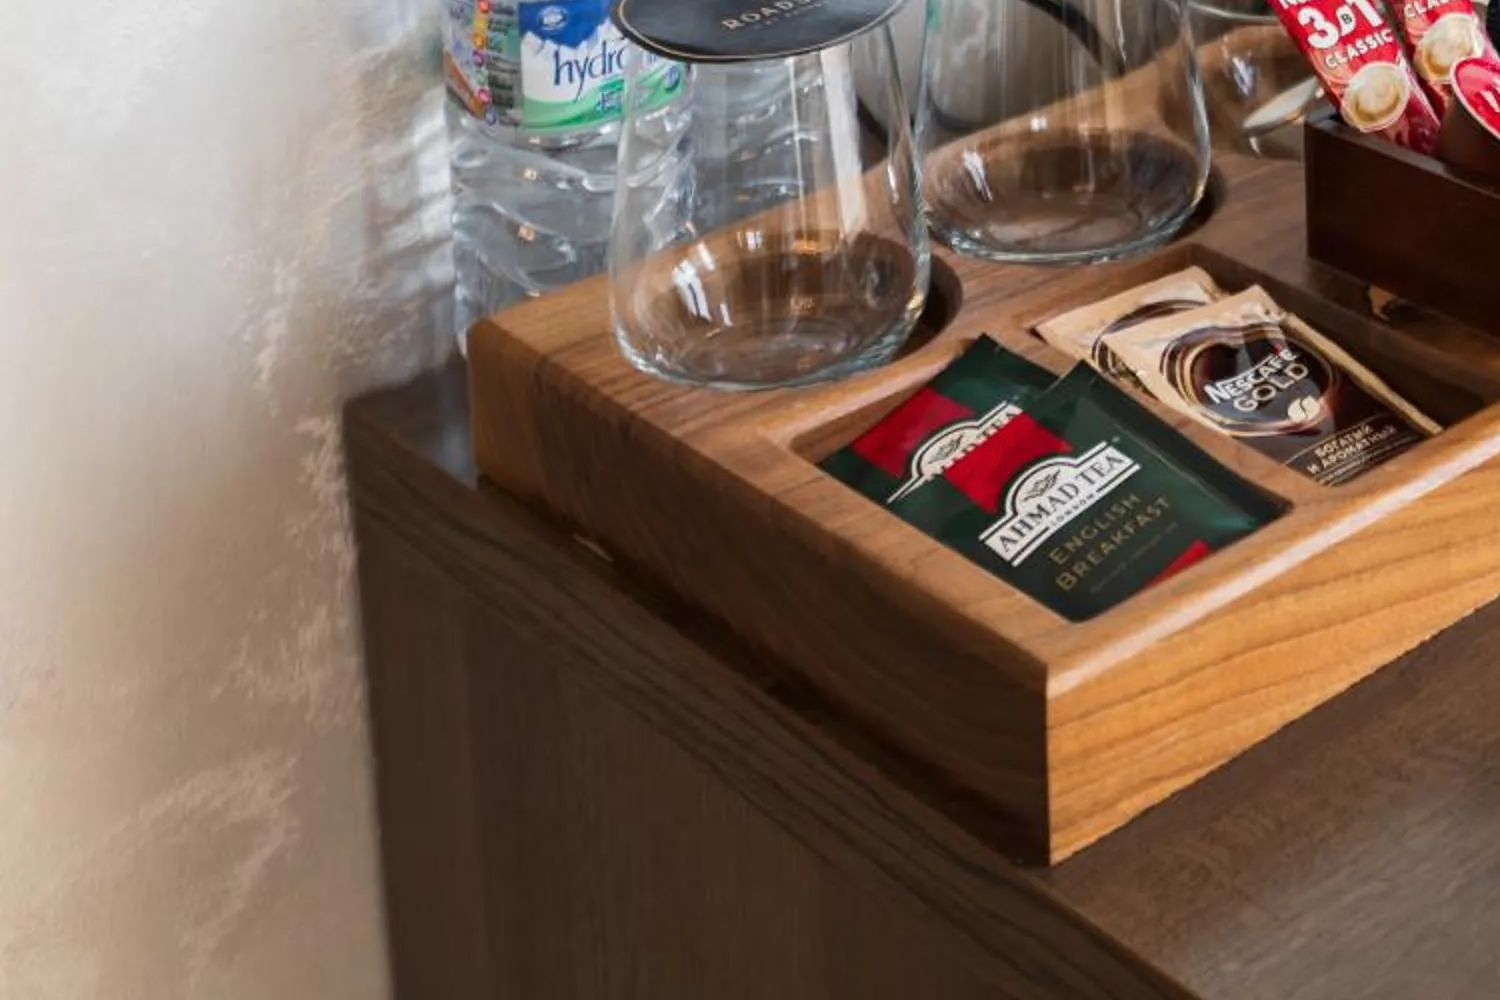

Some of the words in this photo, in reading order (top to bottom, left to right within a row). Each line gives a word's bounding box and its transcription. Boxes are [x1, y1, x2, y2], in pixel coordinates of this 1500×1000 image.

[1326, 28, 1393, 68] CLASSIC
[1233, 363, 1309, 412] GOLD
[999, 482, 1080, 553] AHMAD
[1076, 453, 1124, 486] TEA
[1050, 492, 1141, 565] ENGLISH
[1056, 496, 1171, 591] BREAKFAST
